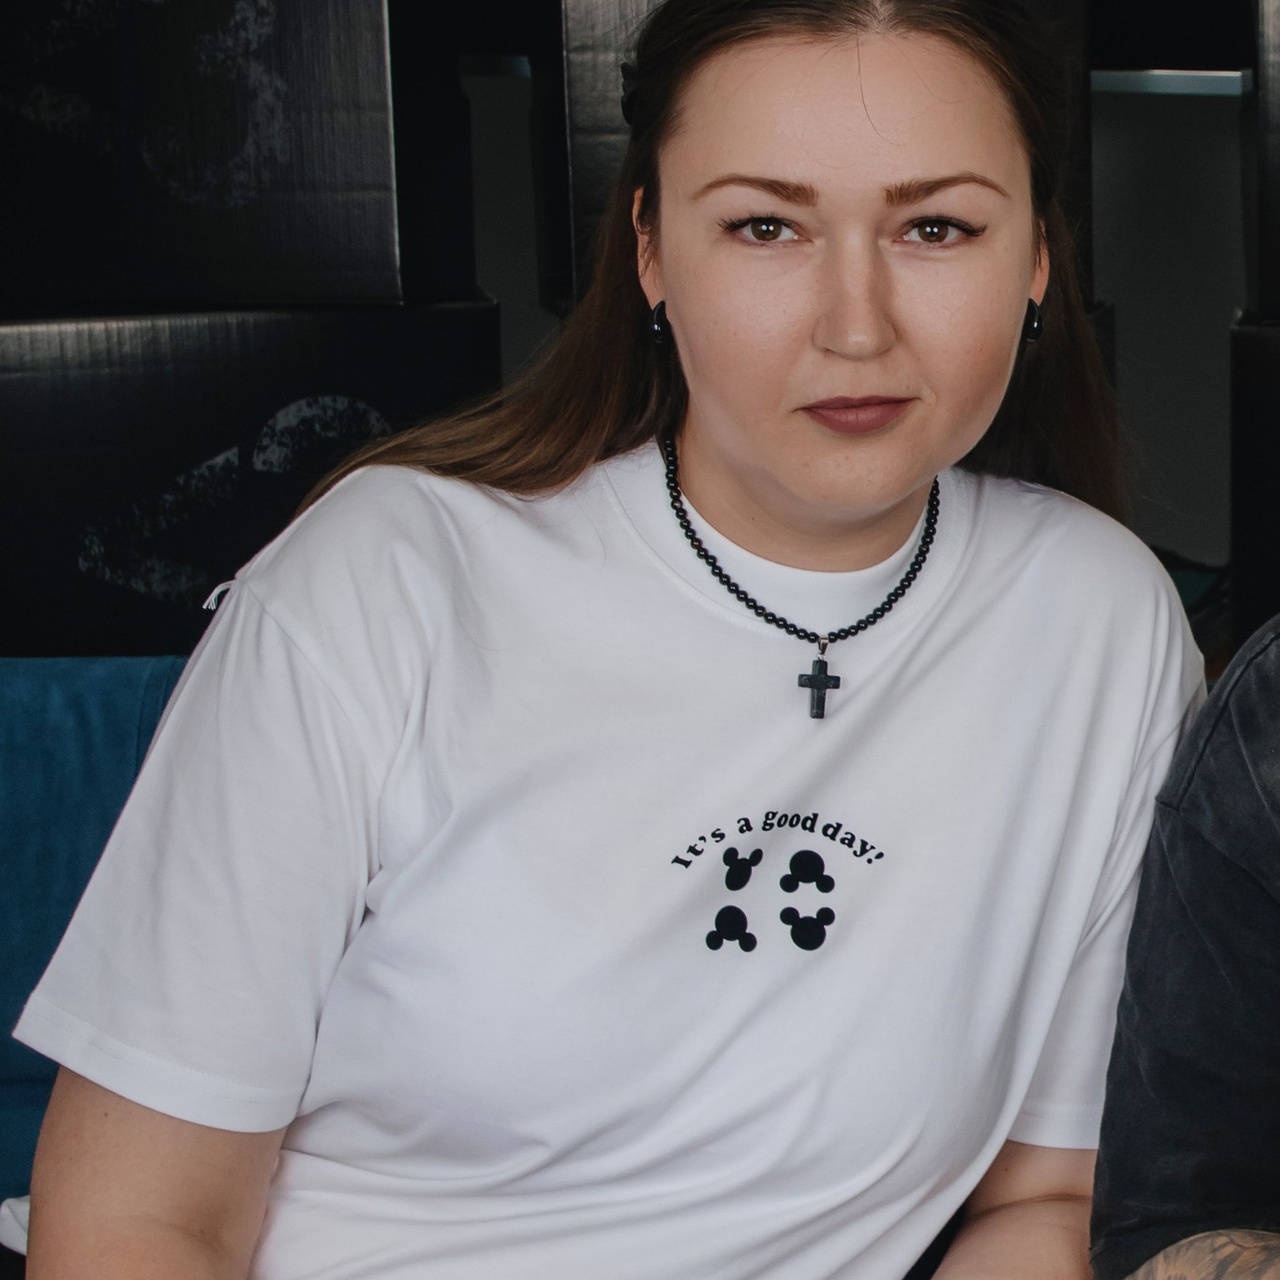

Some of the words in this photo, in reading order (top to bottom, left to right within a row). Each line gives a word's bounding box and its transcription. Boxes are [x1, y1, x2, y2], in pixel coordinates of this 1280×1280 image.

[671, 828, 726, 869] It's
[737, 817, 753, 834] a
[761, 810, 819, 833] good
[821, 822, 885, 865] day!
